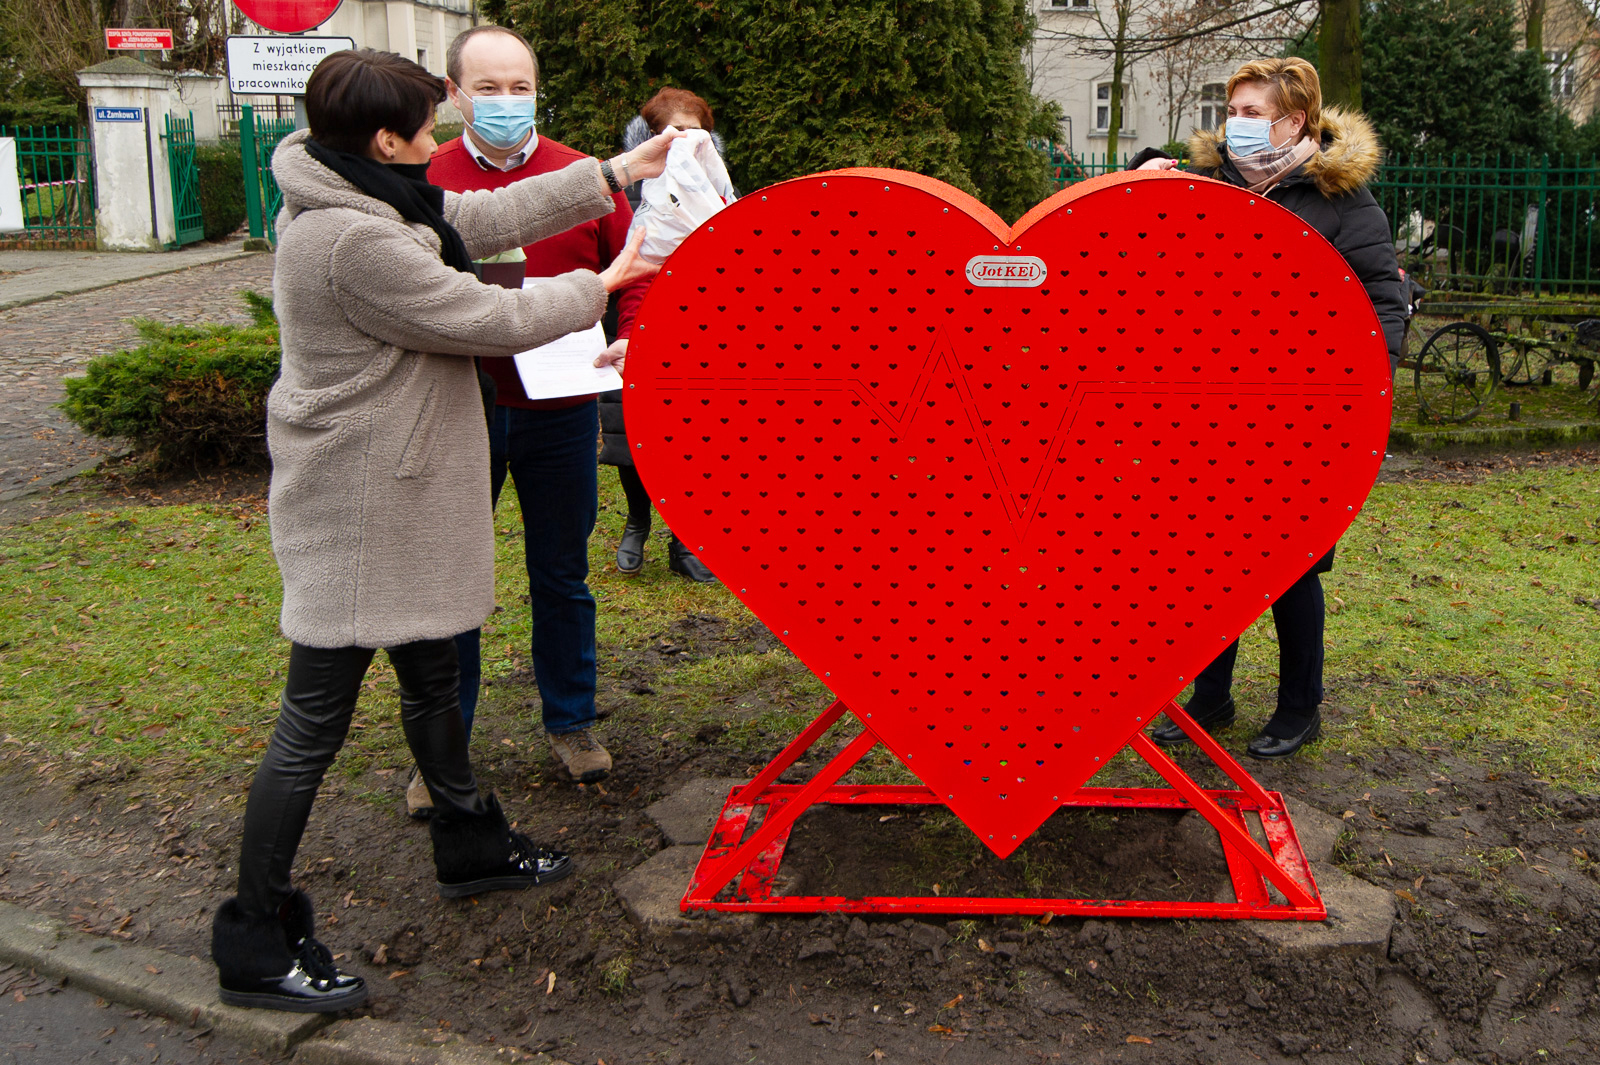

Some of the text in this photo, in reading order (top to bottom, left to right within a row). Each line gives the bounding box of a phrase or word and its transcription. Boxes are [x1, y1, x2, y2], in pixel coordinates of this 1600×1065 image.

[253, 42, 326, 57] Z wyjątkiem
[252, 60, 318, 72] mieszkańcó
[232, 77, 308, 90] i pracownikó
[98, 110, 139, 119] ul. Zamkowa 1
